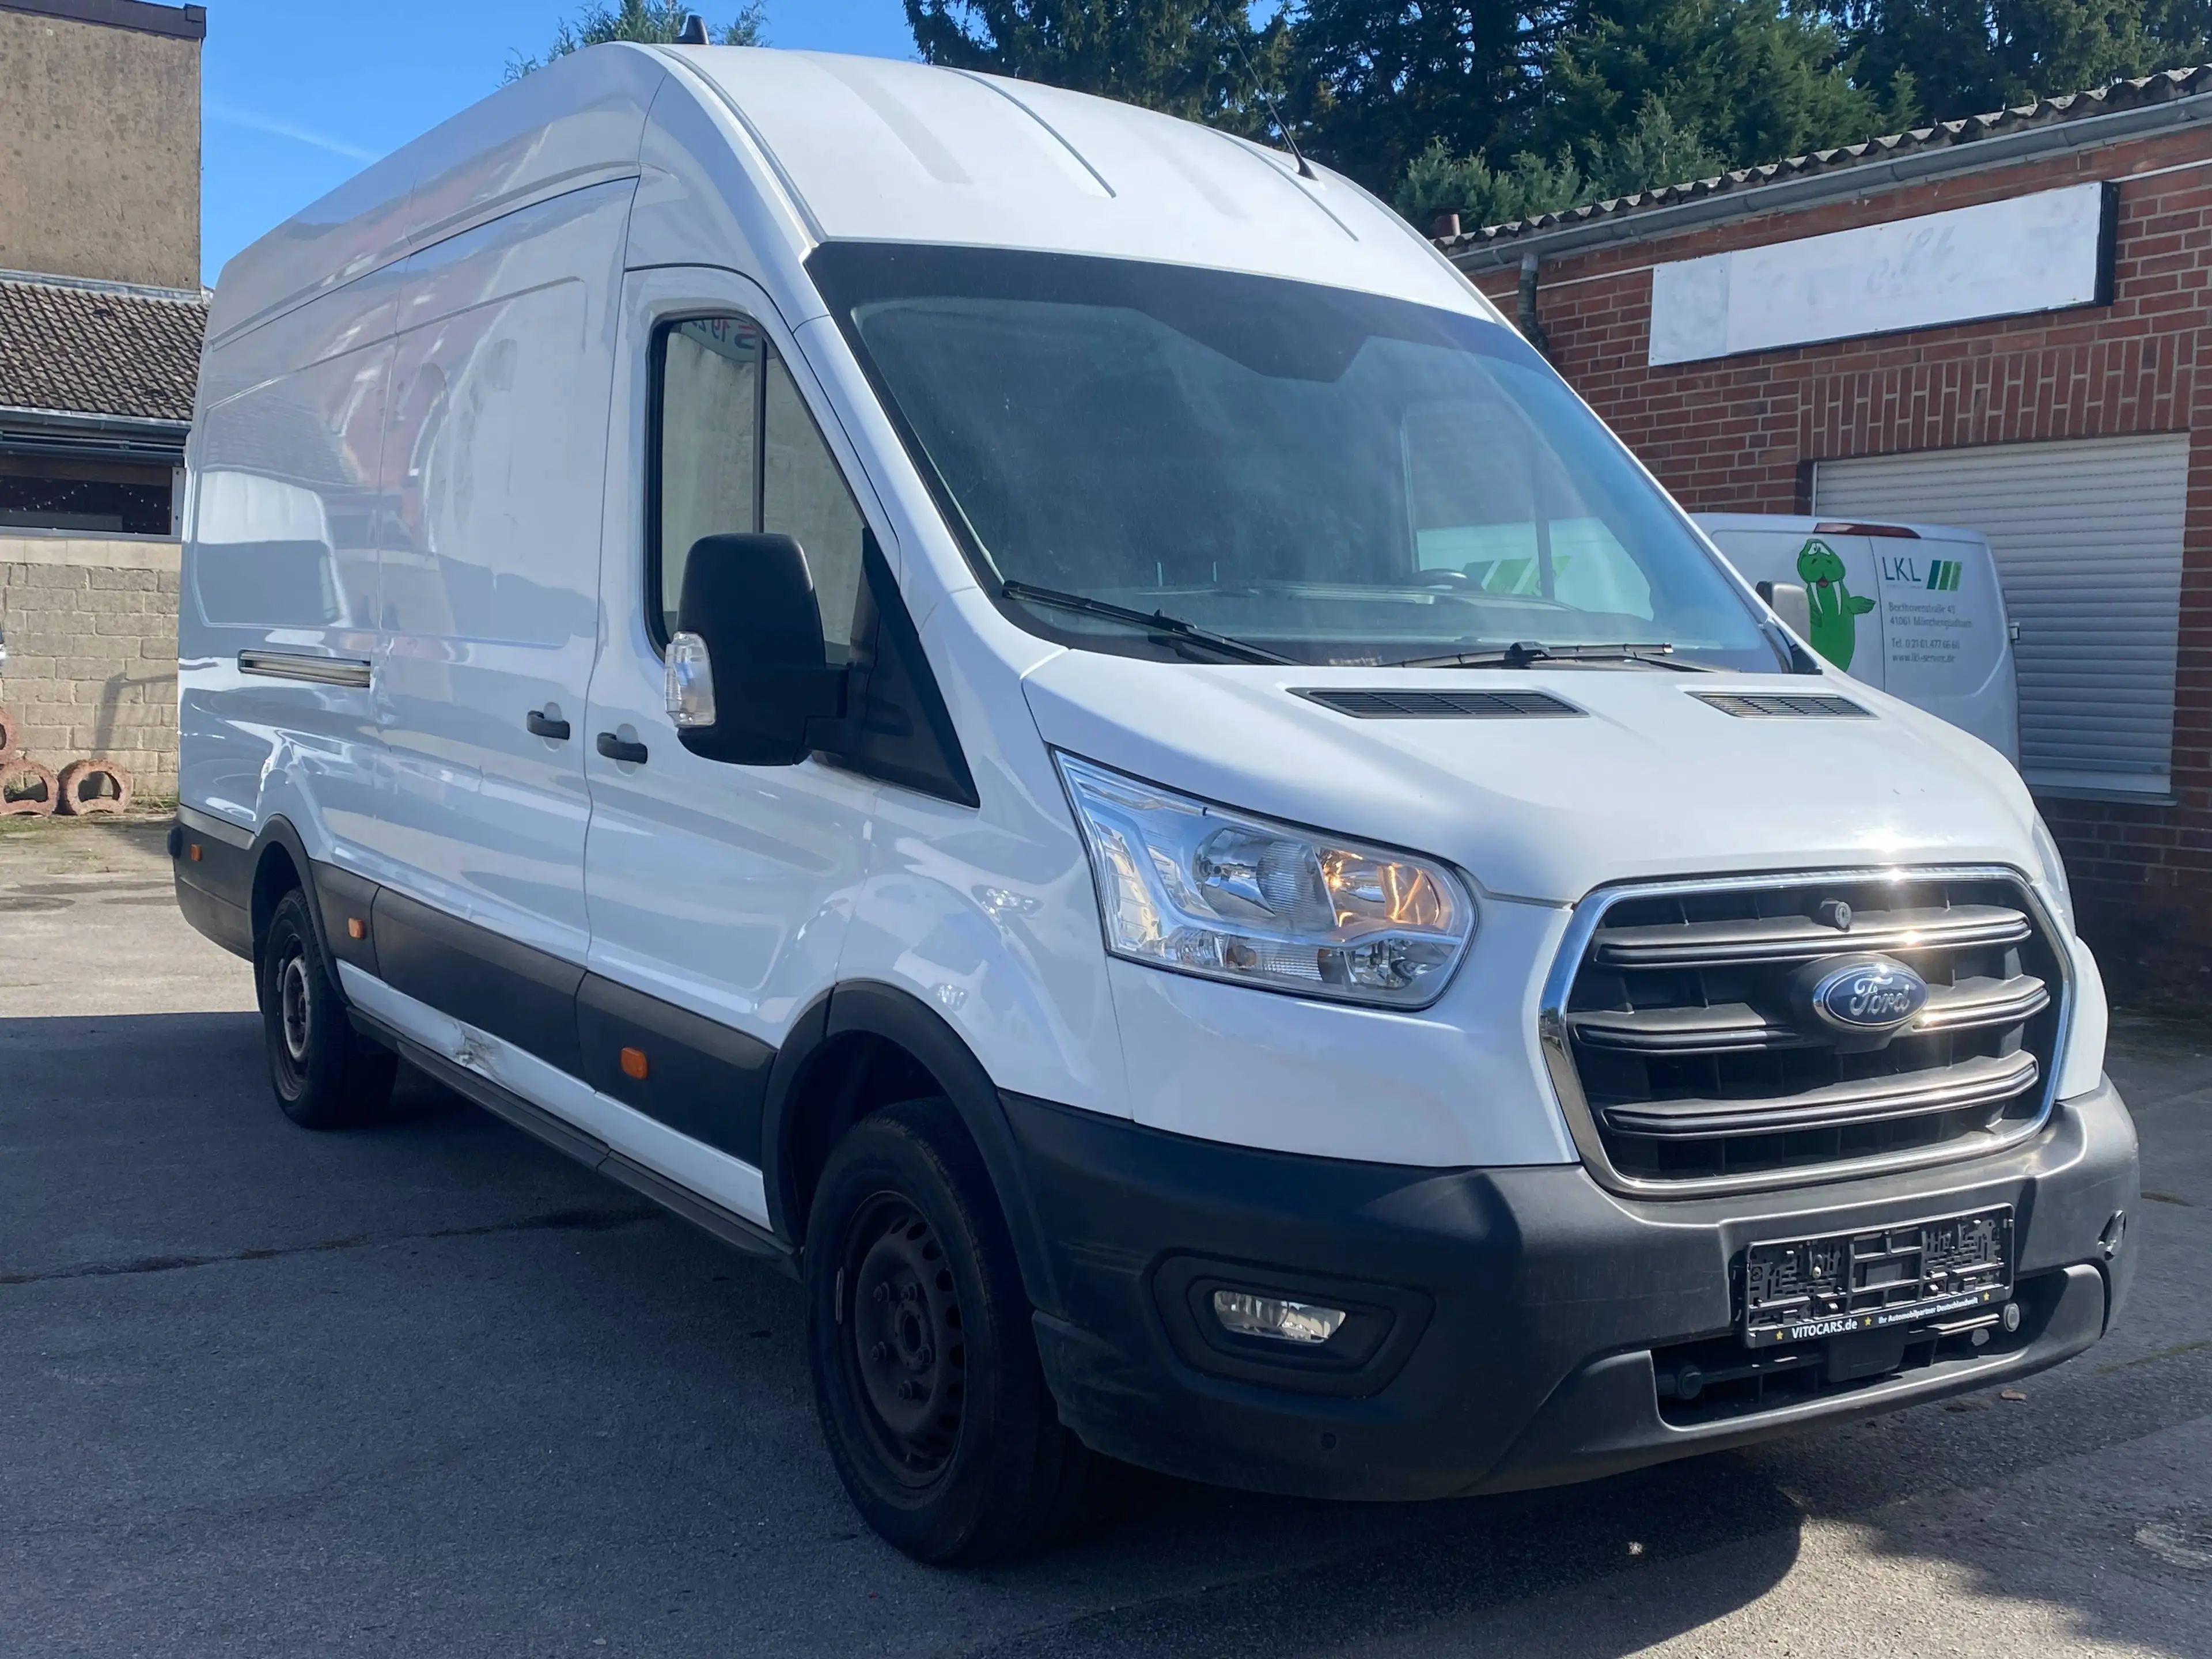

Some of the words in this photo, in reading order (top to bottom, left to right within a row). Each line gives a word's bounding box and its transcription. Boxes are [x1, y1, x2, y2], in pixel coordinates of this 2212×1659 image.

[1882, 556, 1922, 581] LKL
[1850, 976, 1910, 1016] Ford
[1878, 1316, 1887, 1324] Ihr
[1888, 1307, 1936, 1323] Automobilpartner
[1937, 1297, 1979, 1312] Deutschlandweit
[1791, 1318, 1858, 1339] VITOCARS.de
